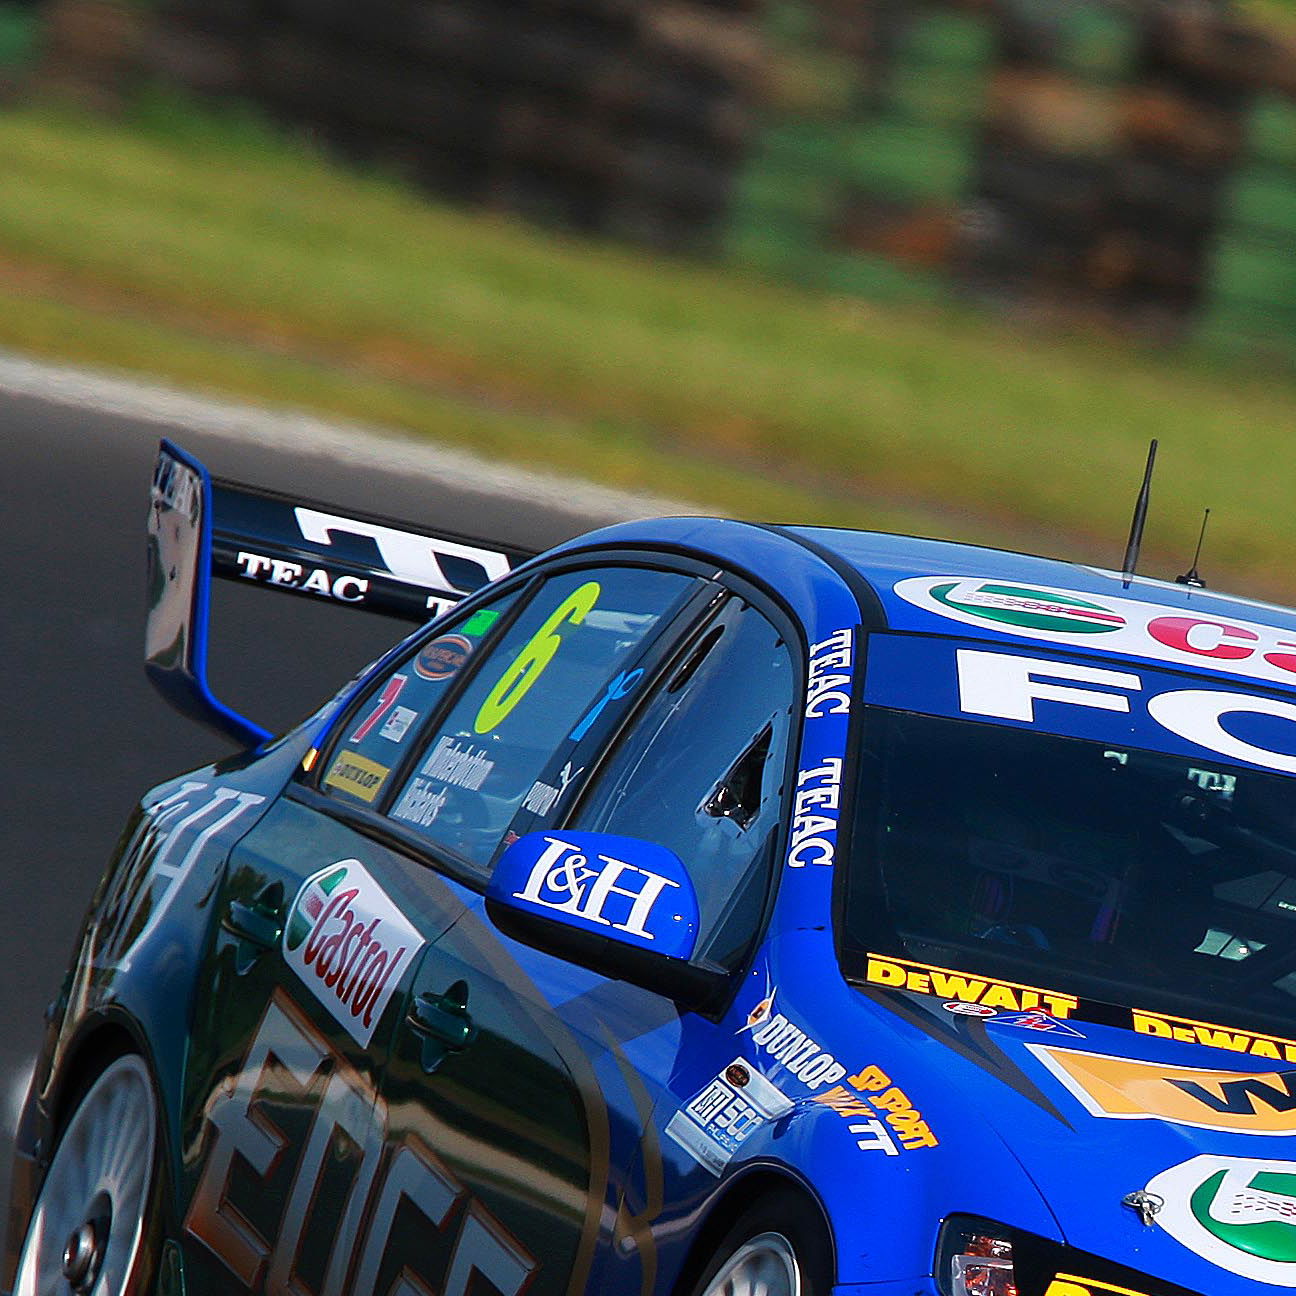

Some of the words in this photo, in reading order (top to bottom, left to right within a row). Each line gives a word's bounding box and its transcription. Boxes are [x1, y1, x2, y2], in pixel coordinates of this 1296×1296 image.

[236, 551, 370, 602] TEAC
[474, 582, 600, 735] 6
[806, 628, 852, 719] TEAC
[788, 757, 842, 868] TEAC
[513, 836, 680, 942] L&H
[304, 885, 408, 1030] Castrol
[752, 1013, 847, 1090] DUNLOP
[867, 1087, 939, 1150] SPORT
